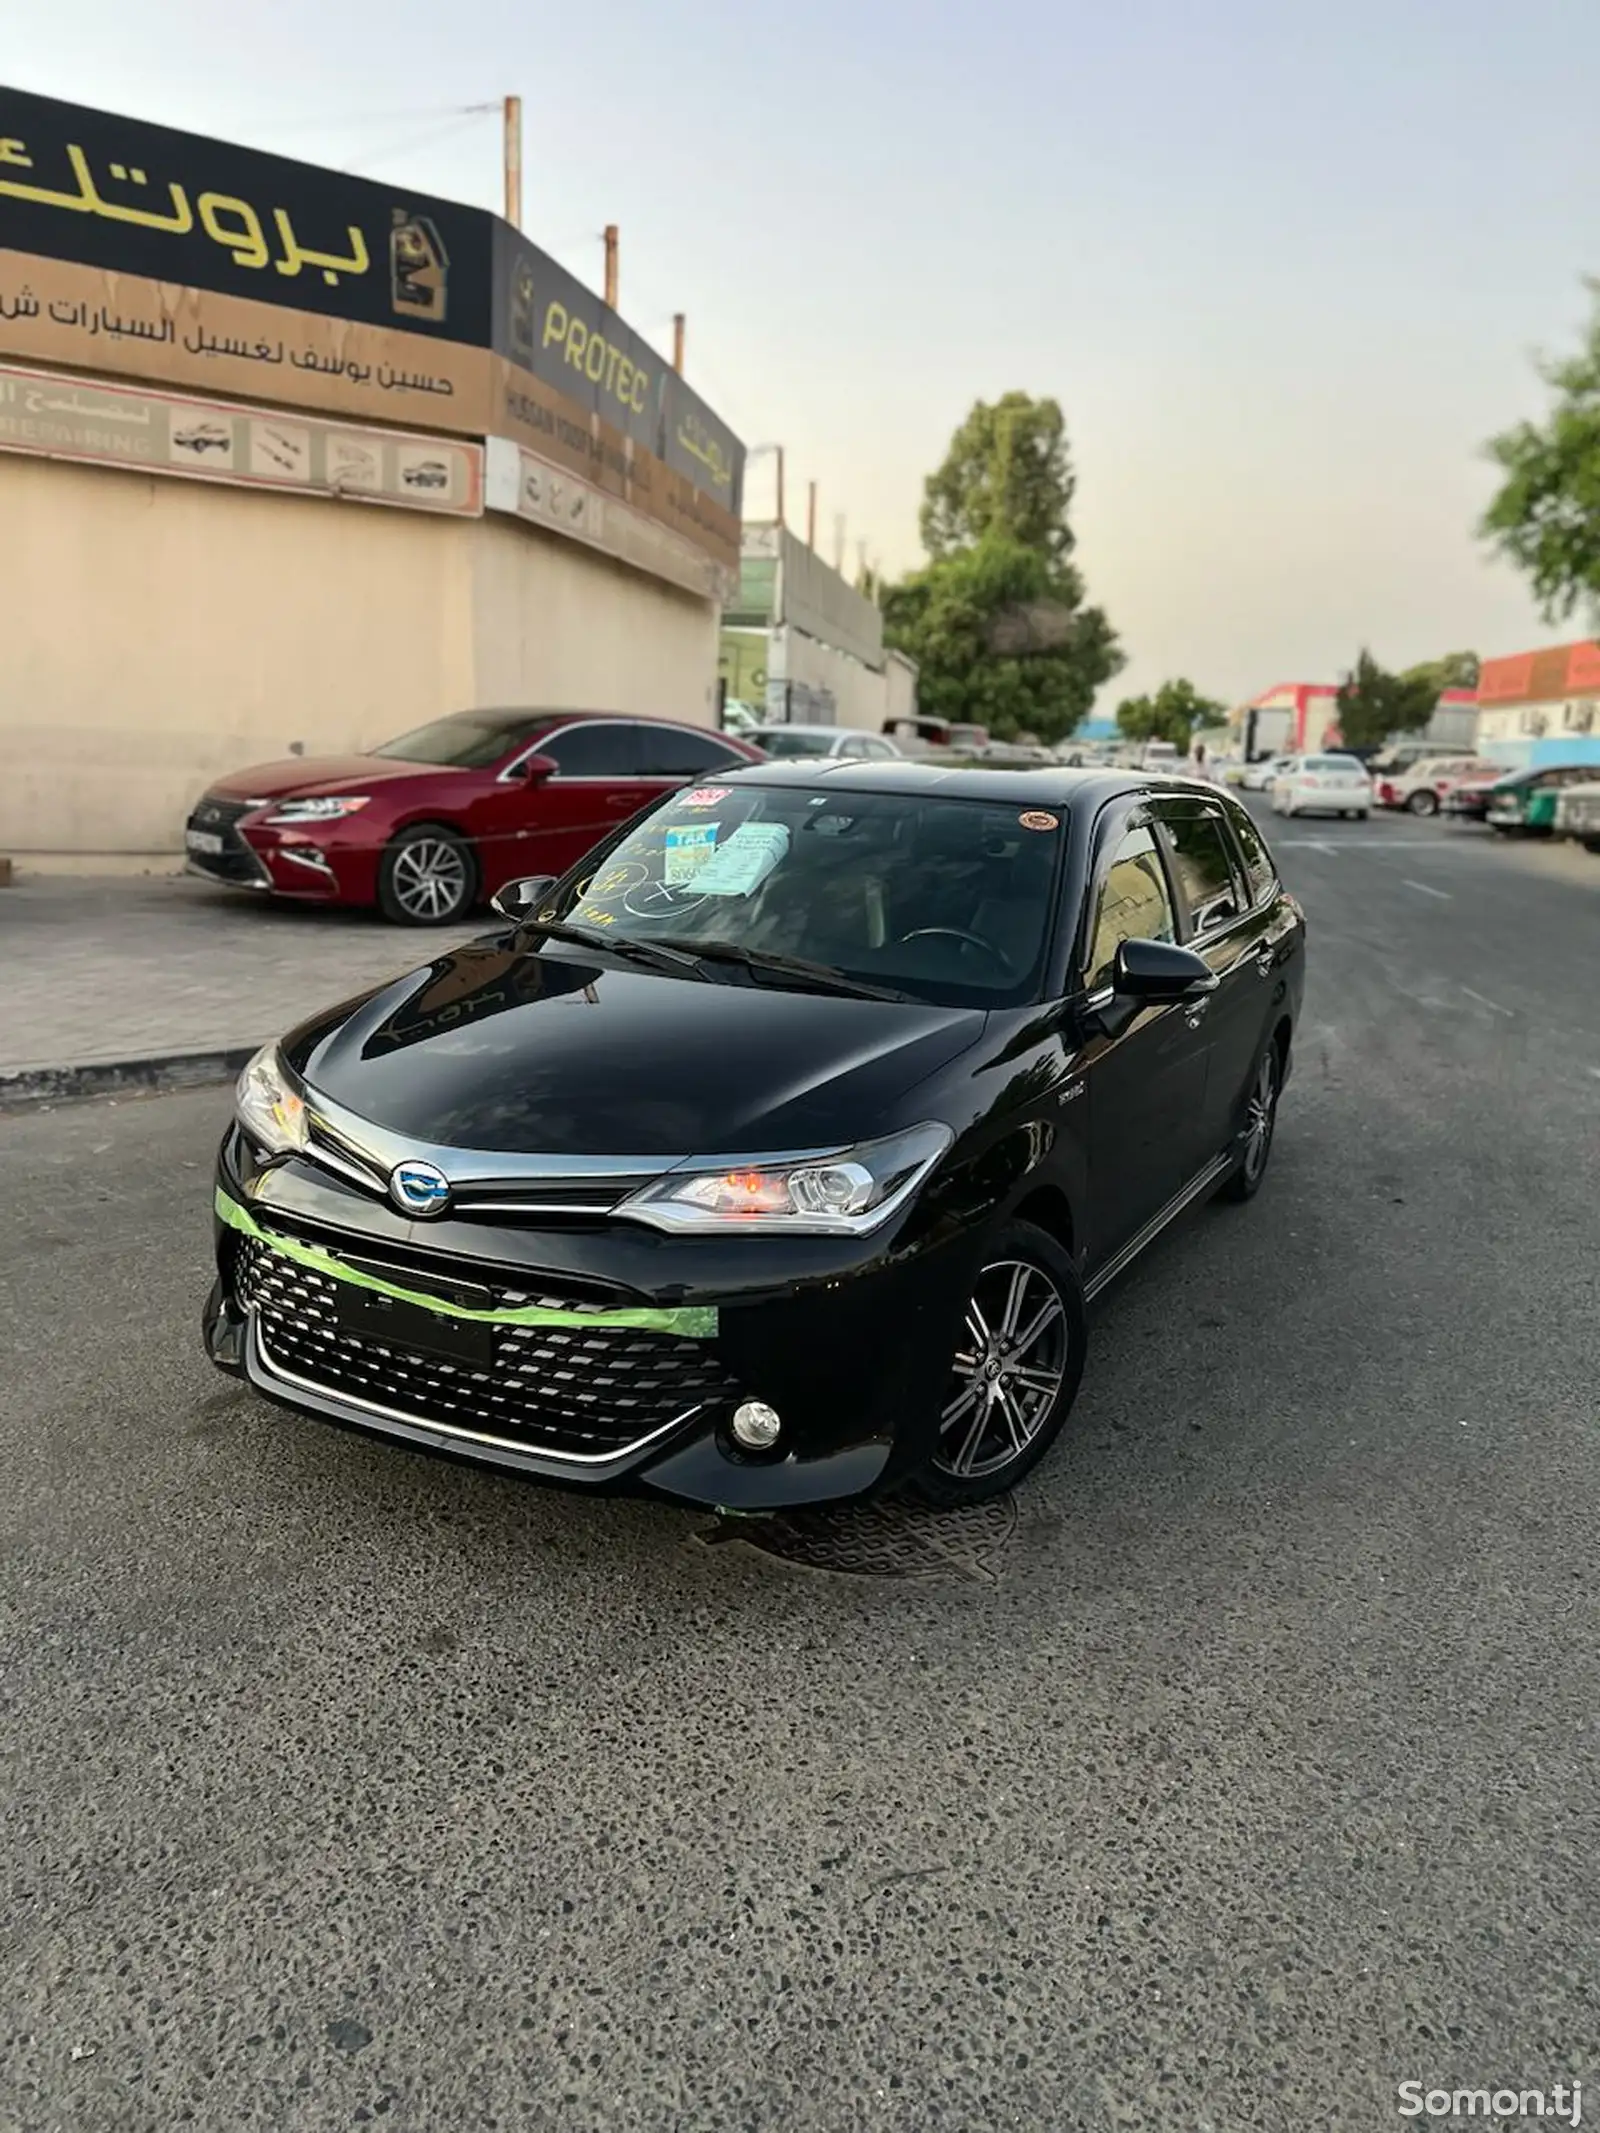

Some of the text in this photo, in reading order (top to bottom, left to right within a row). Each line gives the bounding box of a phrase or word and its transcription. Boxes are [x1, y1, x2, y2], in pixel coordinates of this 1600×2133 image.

[48, 300, 176, 344] السيارات
[183, 325, 283, 364] لغسيل
[289, 343, 371, 384] يوسف
[542, 301, 649, 414] PROTEC
[377, 361, 453, 396] حسين
